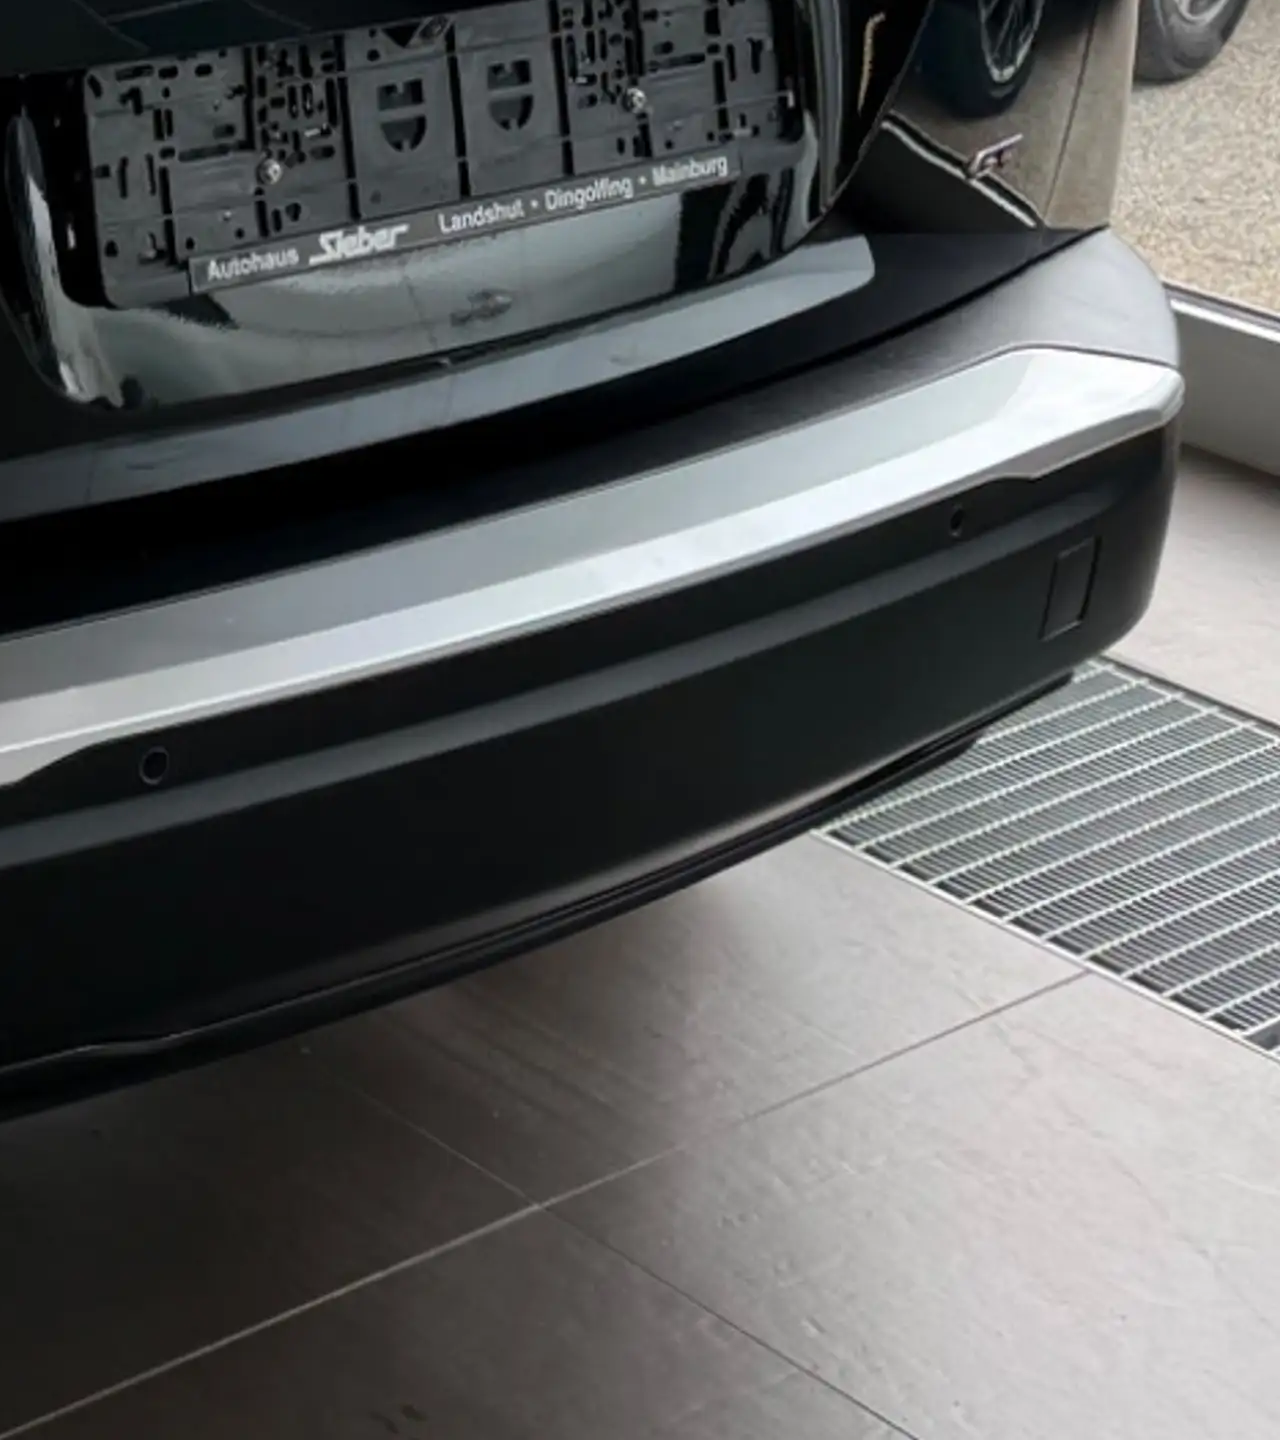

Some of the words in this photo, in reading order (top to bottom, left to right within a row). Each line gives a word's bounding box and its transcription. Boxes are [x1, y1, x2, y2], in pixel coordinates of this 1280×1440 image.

[207, 248, 300, 282] Autohaus
[308, 224, 409, 266] Sieber
[438, 198, 525, 234] Landshut
[544, 176, 634, 212] Dingolfing
[651, 156, 728, 186] Mainburg
